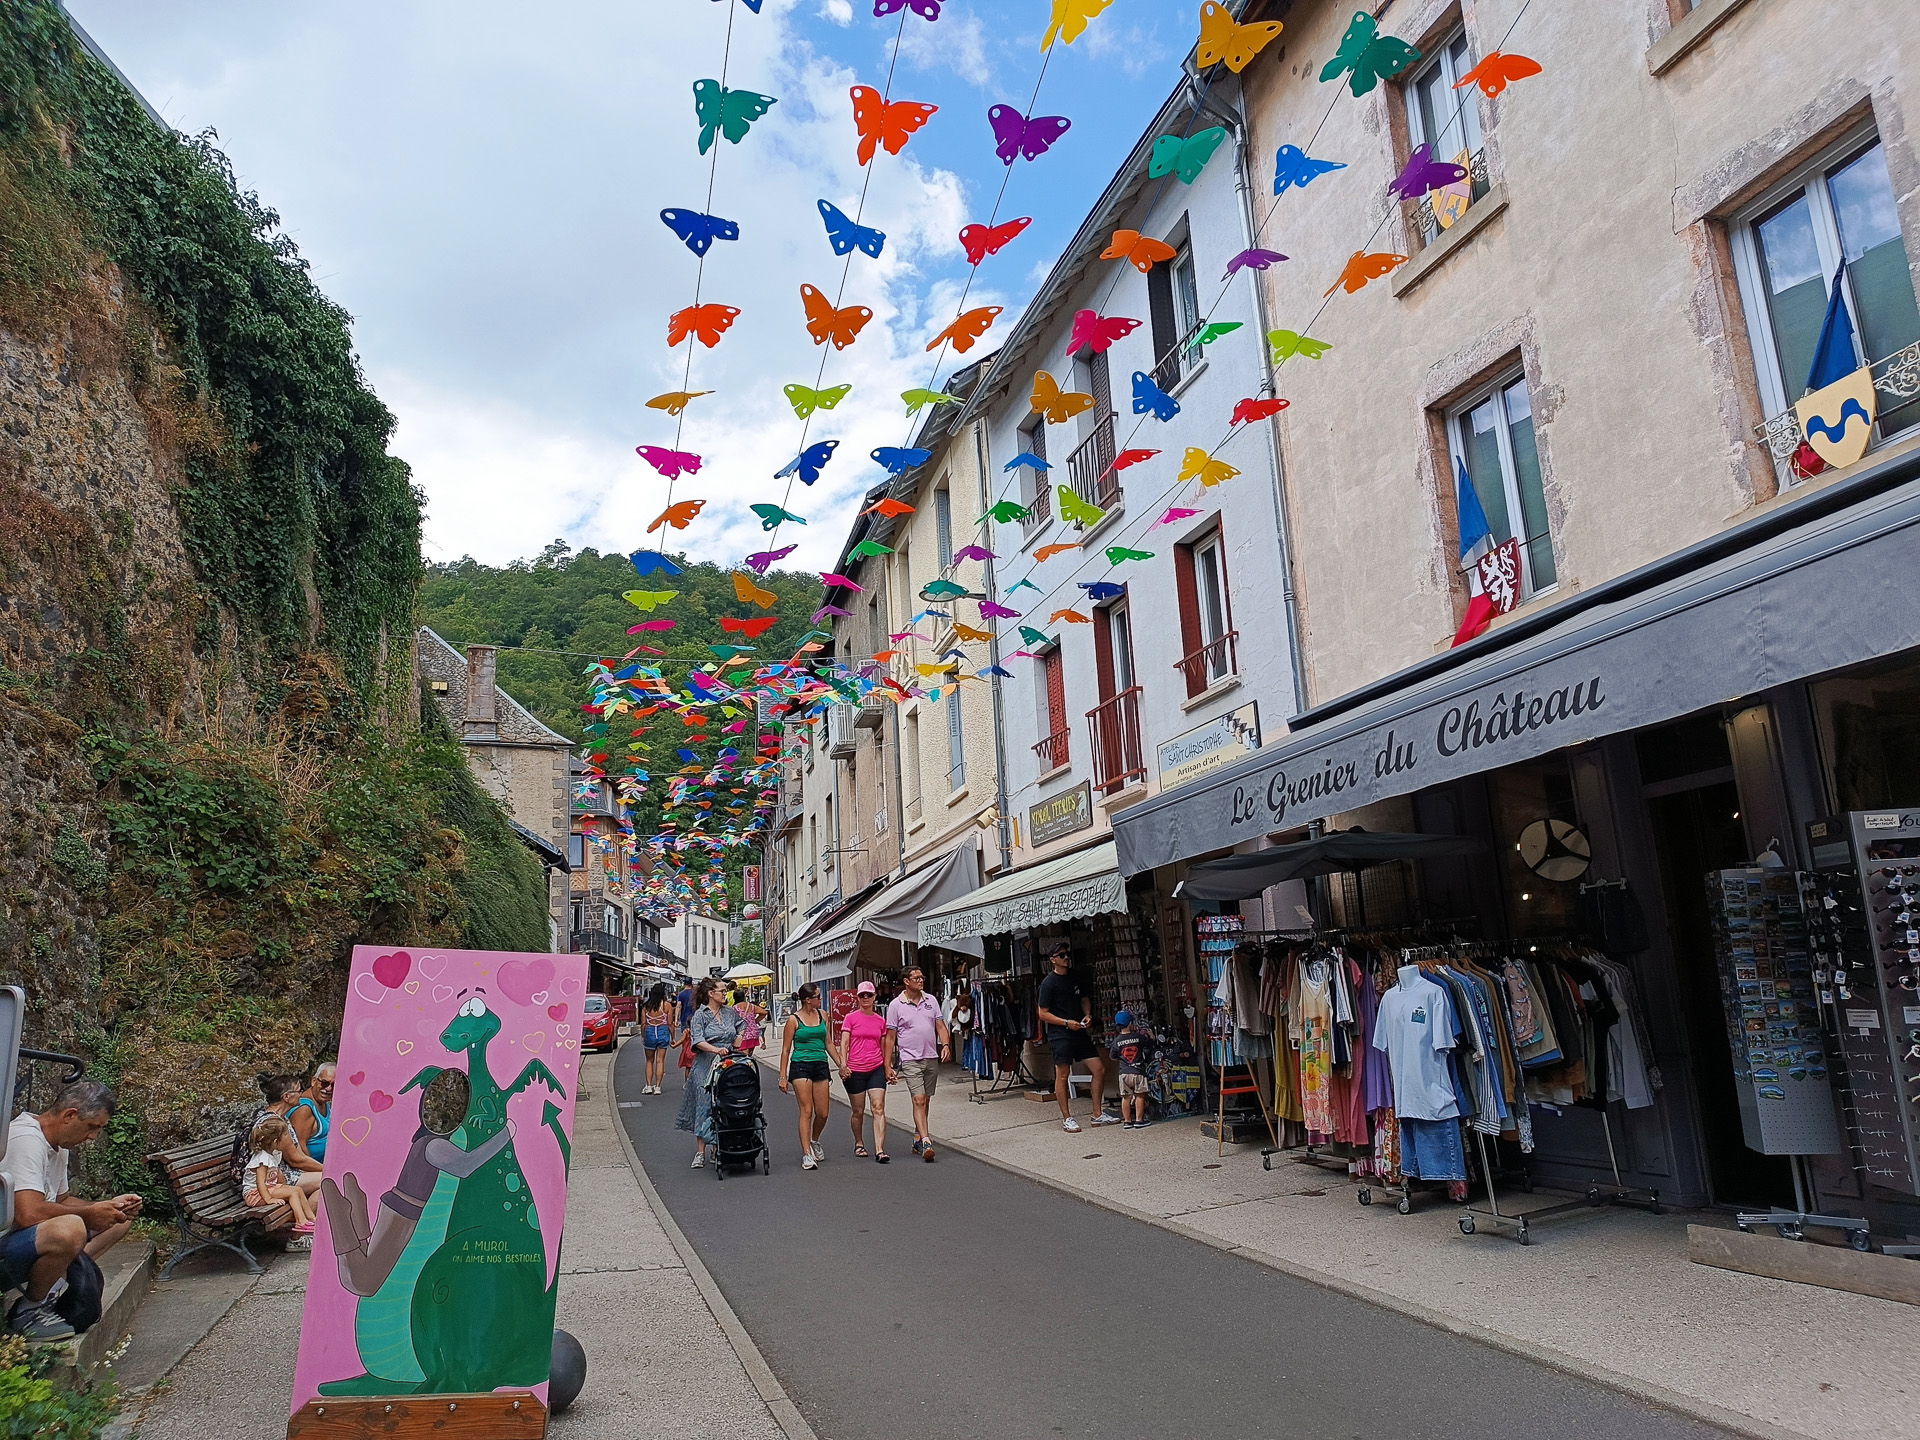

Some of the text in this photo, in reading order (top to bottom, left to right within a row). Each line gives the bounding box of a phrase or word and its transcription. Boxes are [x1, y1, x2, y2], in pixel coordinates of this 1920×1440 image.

[1160, 743, 1180, 755] ATELIER
[1184, 732, 1223, 759] CHRISTOPHE
[1231, 676, 1607, 826] Le Grenier du Château
[1177, 761, 1202, 777] Artisan
[1202, 755, 1220, 767] d'art
[1018, 898, 1045, 922] SAINT
[1049, 882, 1110, 916] CHRISTOPHE
[1117, 1038, 1139, 1047] SUPERMAN
[486, 1254, 502, 1263] NOS
[505, 1252, 541, 1263] BESTIOLES
